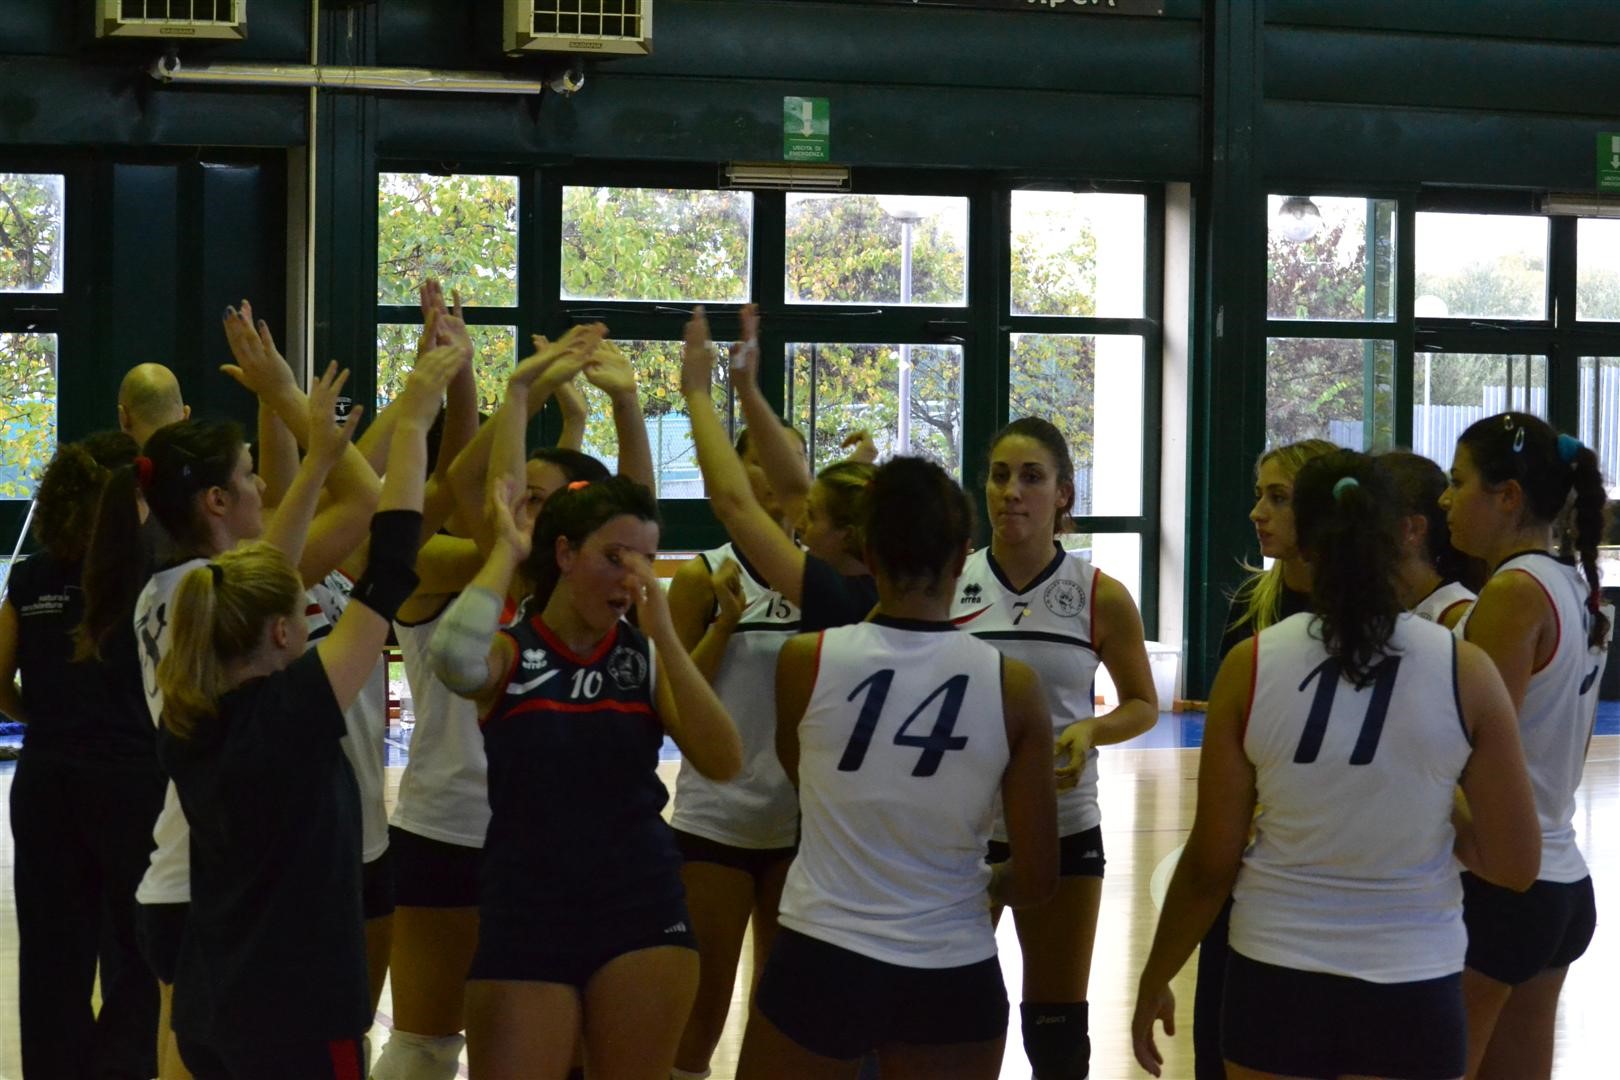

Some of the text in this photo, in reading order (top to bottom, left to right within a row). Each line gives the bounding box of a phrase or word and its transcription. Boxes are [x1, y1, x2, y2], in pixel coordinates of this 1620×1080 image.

[765, 595, 791, 619] 15
[1012, 601, 1029, 625] 7
[570, 668, 603, 699] 10
[837, 668, 970, 777] 14
[1293, 655, 1402, 766] 11
